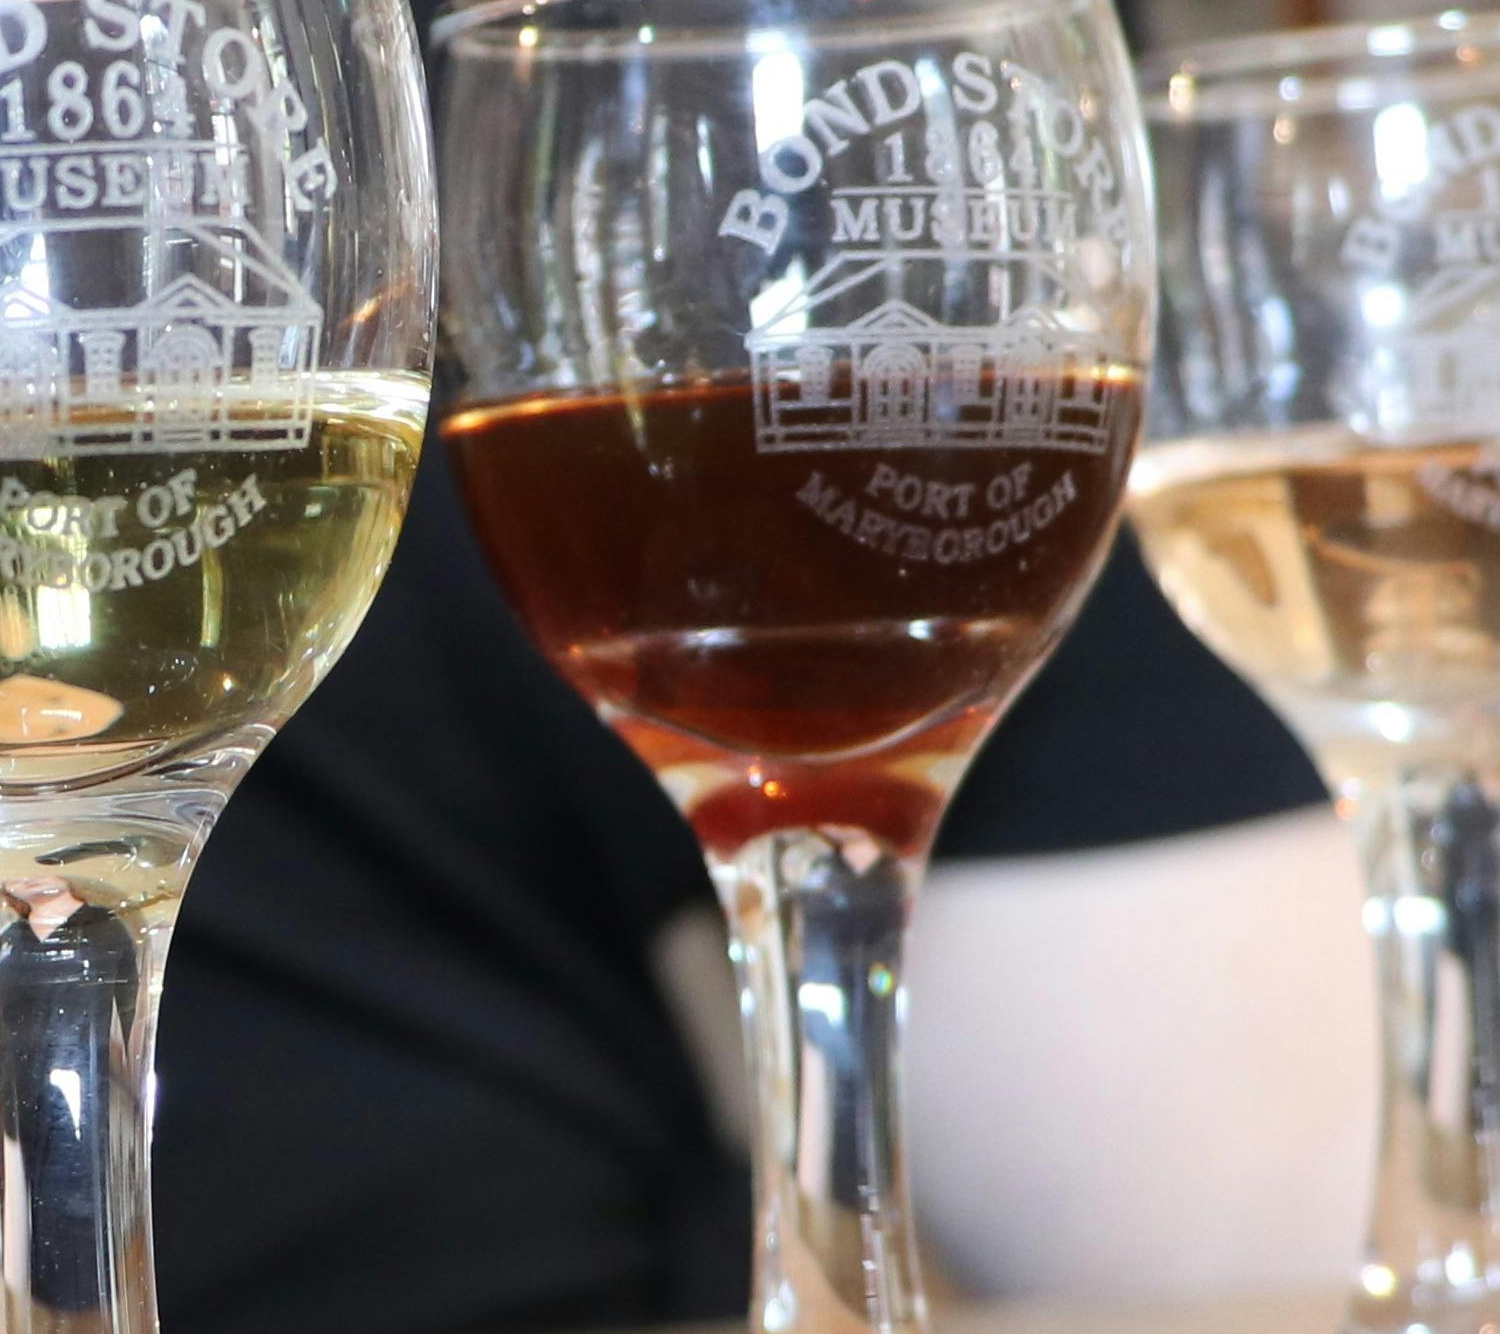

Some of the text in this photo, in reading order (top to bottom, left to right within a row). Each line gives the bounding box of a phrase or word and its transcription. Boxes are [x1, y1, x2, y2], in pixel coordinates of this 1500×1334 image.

[717, 60, 922, 257] BOND
[884, 120, 1037, 190] 1864
[829, 196, 1078, 245] MUSEUM
[136, 467, 198, 529] OF
[796, 469, 1077, 564] MARYBOROUGH
[864, 459, 1032, 519] PORT OF
